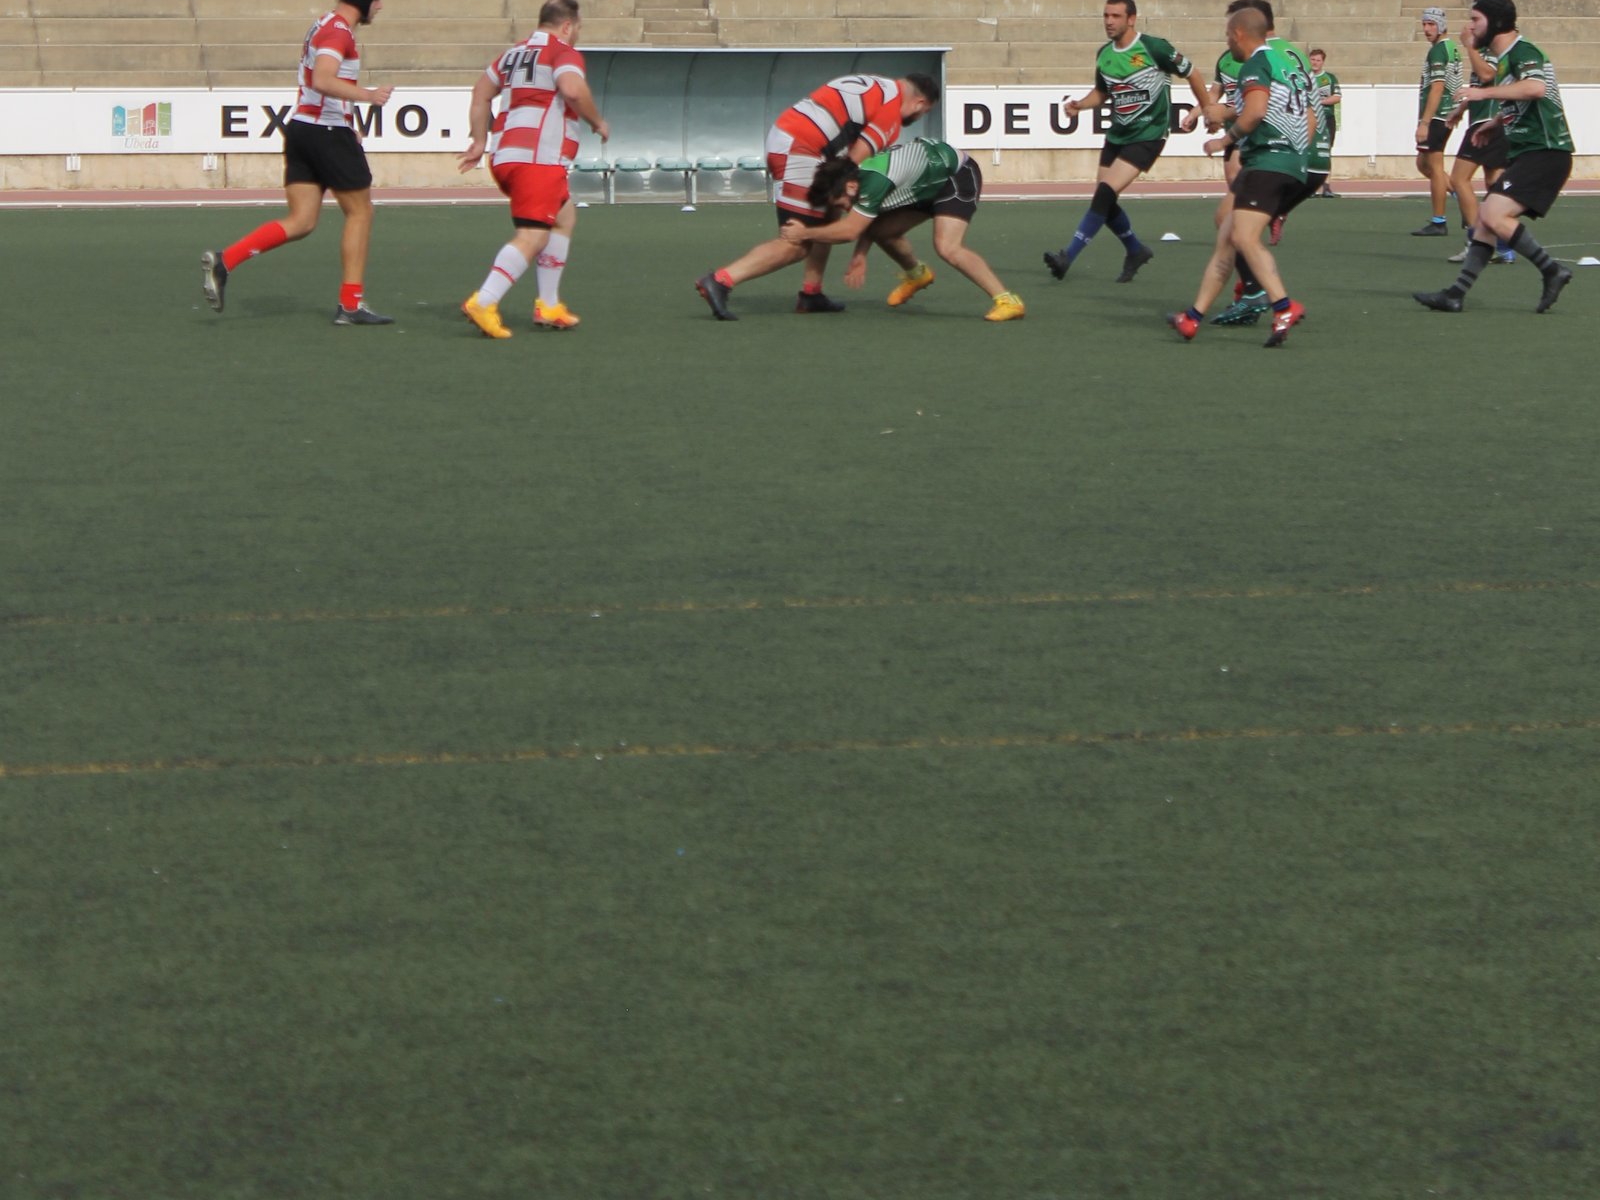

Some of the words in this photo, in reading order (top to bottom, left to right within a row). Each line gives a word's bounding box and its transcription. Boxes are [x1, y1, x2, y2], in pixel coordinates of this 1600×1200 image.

[500, 48, 541, 85] 44
[221, 104, 451, 139] EXMO.
[963, 103, 1031, 135] DE
